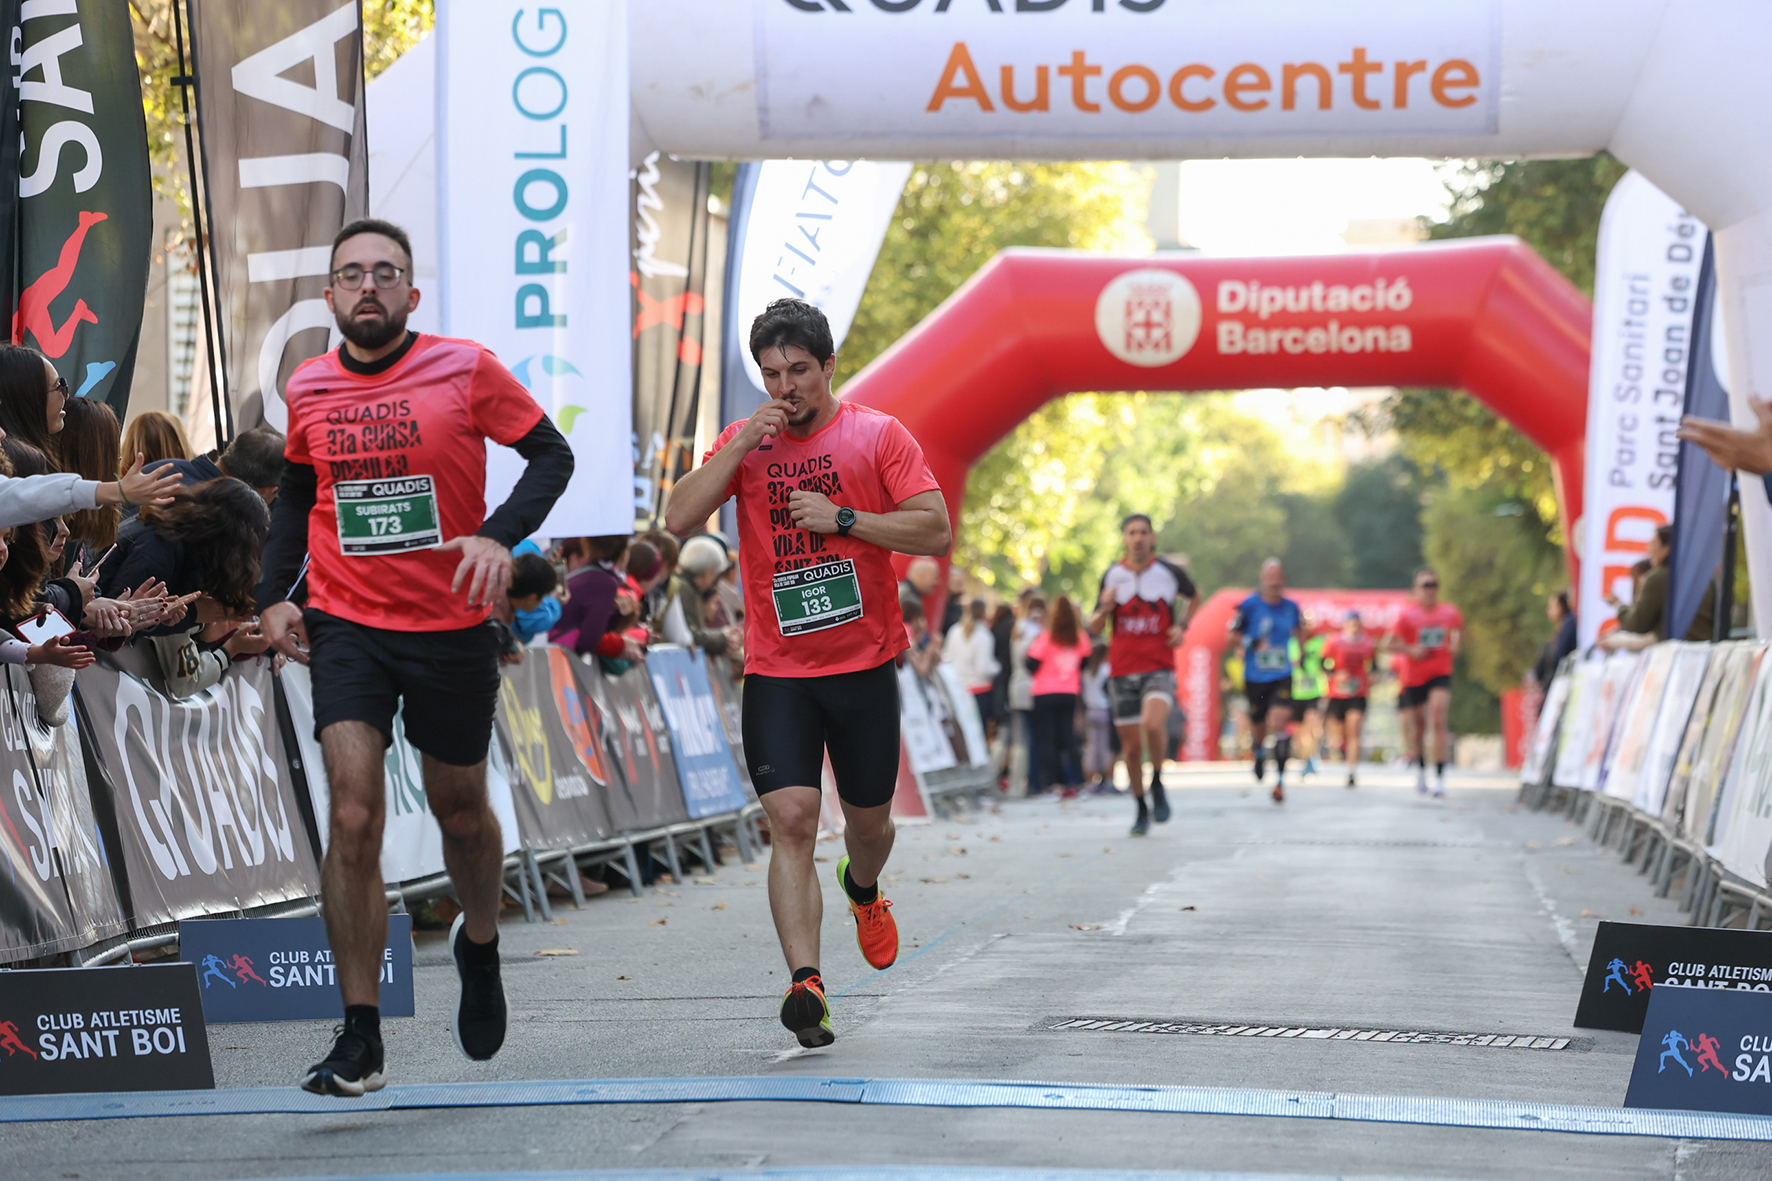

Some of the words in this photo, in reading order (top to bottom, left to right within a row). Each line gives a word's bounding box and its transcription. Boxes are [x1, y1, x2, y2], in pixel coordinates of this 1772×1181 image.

[925, 42, 1482, 114] Autocentre
[19, 0, 104, 198] SA
[512, 8, 568, 329] PROLOG
[1217, 276, 1413, 320] Diputació
[1664, 275, 1691, 314] de
[1217, 319, 1413, 354] Barcelona
[1614, 273, 1651, 403] Sanitari
[1654, 323, 1687, 406] Joan
[326, 400, 411, 425] QUADIS
[362, 420, 423, 451] CURSA
[1608, 412, 1640, 488] Parc
[767, 454, 833, 478] QUADIS
[1648, 415, 1681, 491] Sant
[371, 479, 430, 497] QUADIS
[355, 501, 412, 517] SUBIRATS
[367, 515, 403, 536] 173
[773, 532, 806, 557] VILA
[803, 562, 851, 582] QUADIS
[801, 586, 827, 599] IGOR
[801, 595, 833, 616] 133
[177, 642, 199, 678] 18
[114, 671, 295, 881] QUADIS
[269, 951, 310, 965] CLUB
[1668, 962, 1706, 977] CLUB
[269, 964, 337, 987] SANT
[37, 1014, 85, 1031] CLUB
[90, 1008, 182, 1029] ATLETISME
[38, 1030, 120, 1061] SANT
[131, 1026, 187, 1056] BOI
